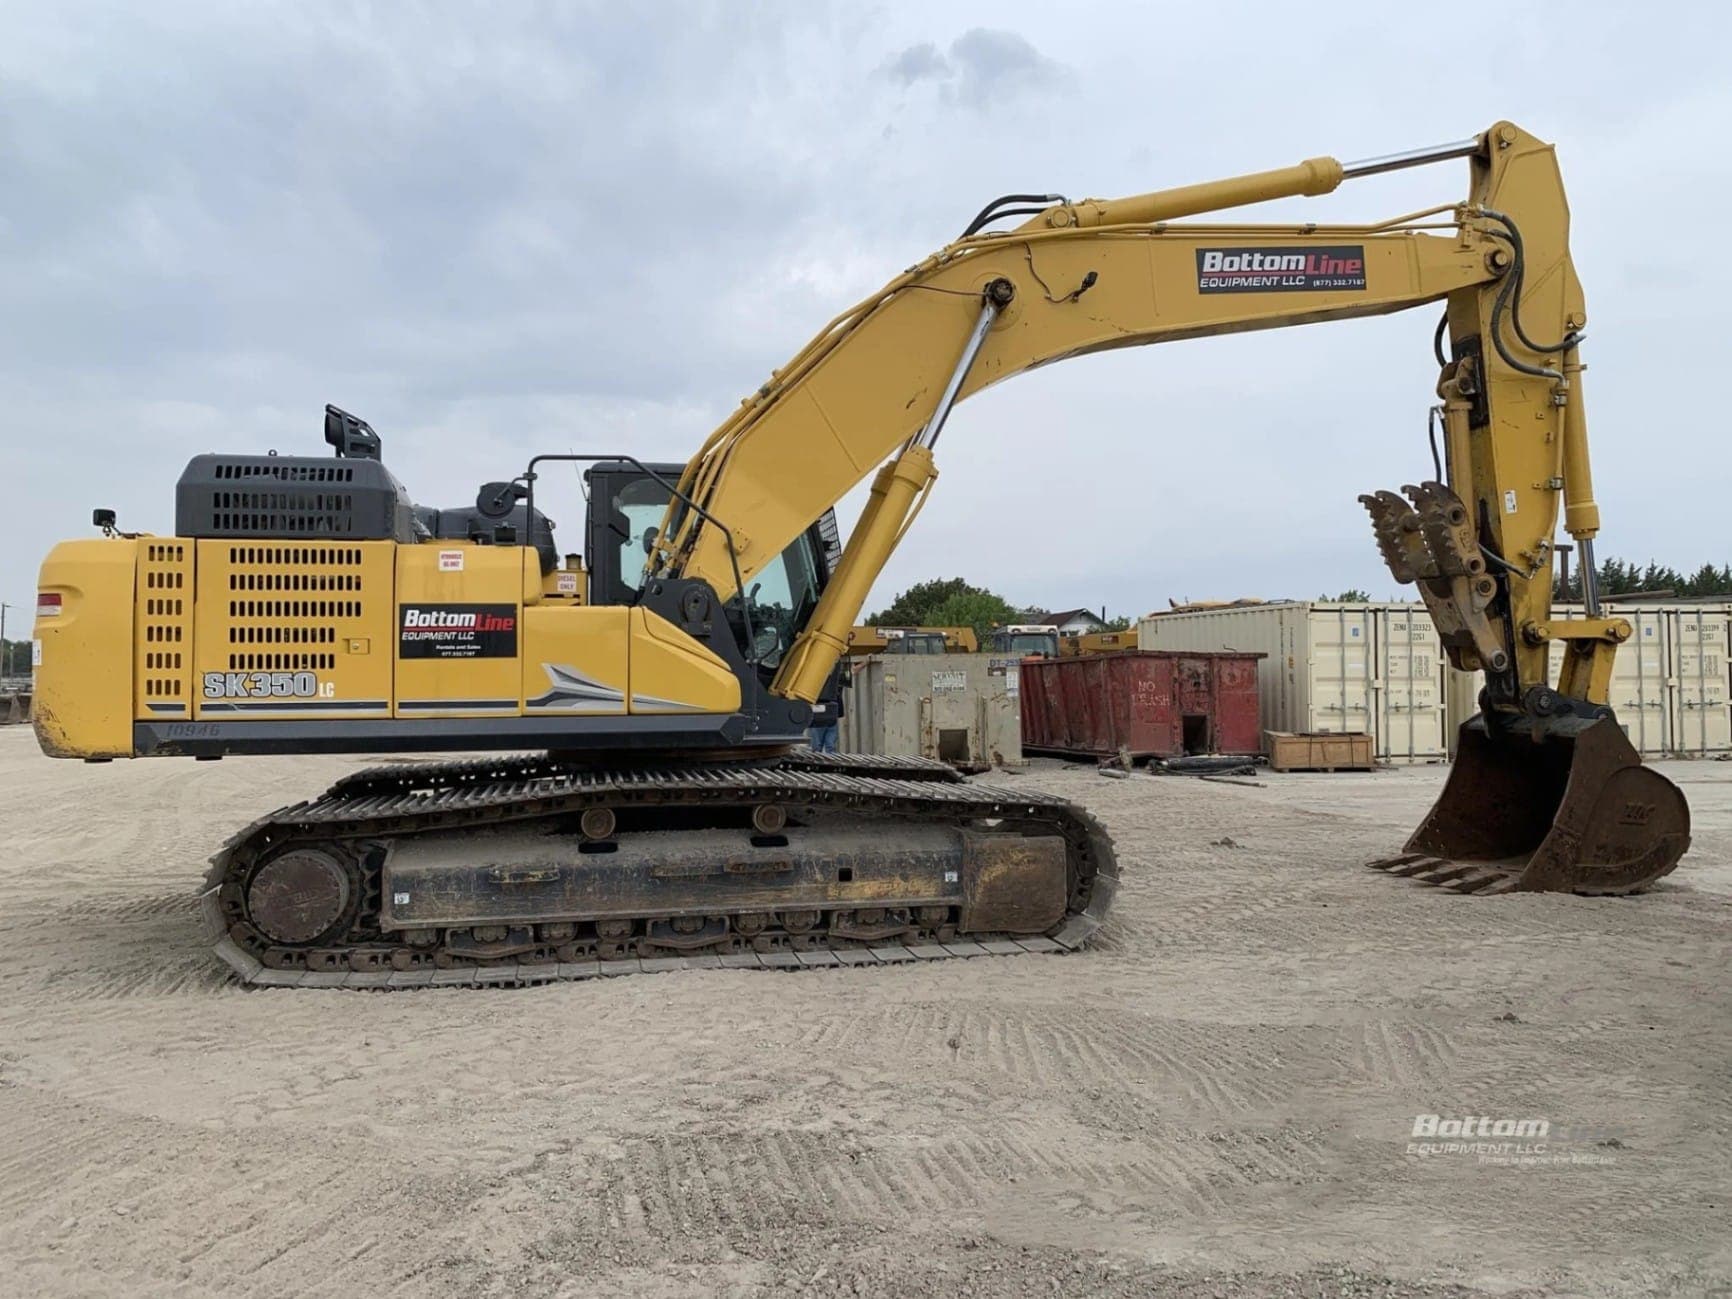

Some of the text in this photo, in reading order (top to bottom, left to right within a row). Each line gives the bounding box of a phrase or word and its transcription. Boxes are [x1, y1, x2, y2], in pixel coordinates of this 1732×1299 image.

[1200, 277, 1281, 288] EQUIPMENT
[1282, 275, 1306, 286] LLC
[402, 632, 475, 641] EQUIPMENT LLC
[204, 671, 335, 698] SK350 LC
[1138, 680, 1156, 692] NO
